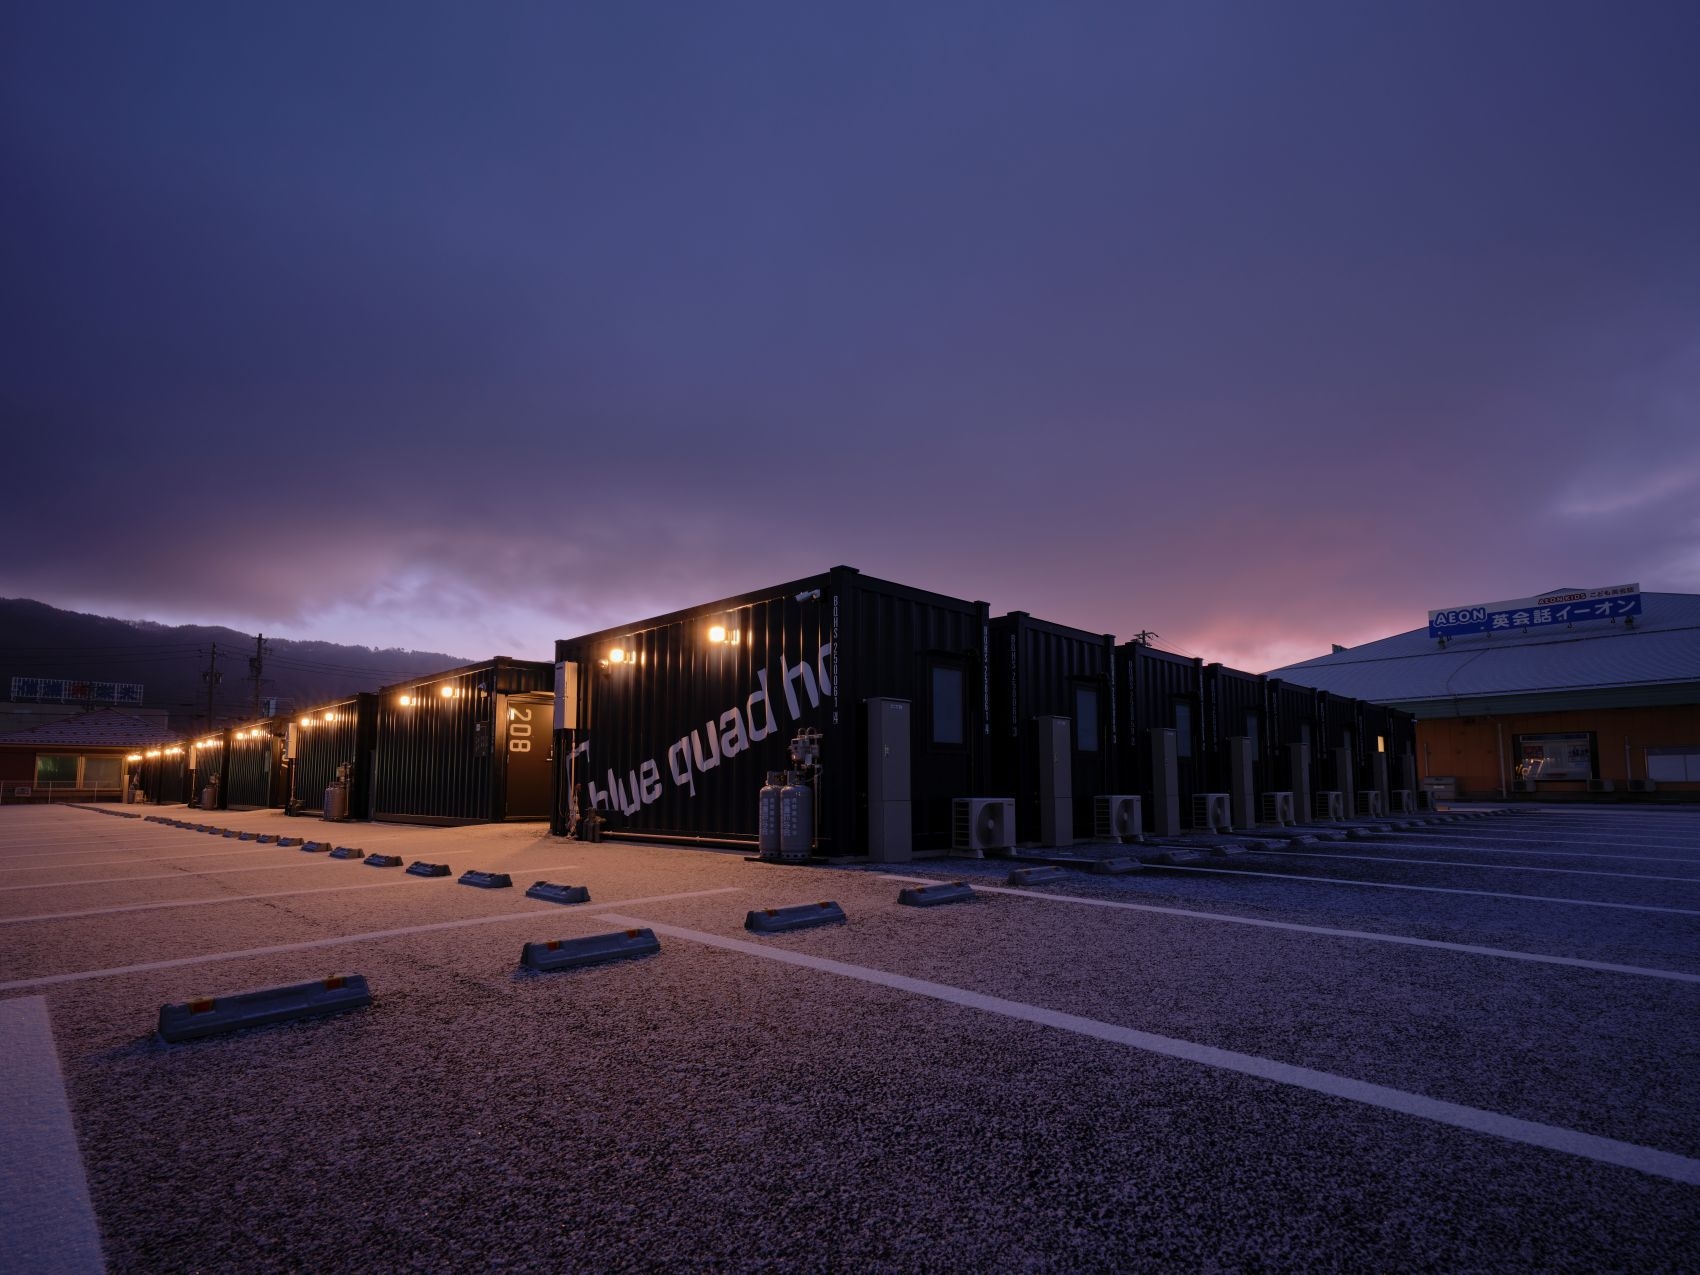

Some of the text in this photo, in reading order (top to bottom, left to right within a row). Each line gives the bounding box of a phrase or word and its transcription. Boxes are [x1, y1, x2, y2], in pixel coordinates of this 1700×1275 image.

[1434, 607, 1487, 627] AEON
[1492, 599, 1636, 629] 英会話イーオン
[509, 707, 532, 753] 208
[668, 667, 778, 798] quad
